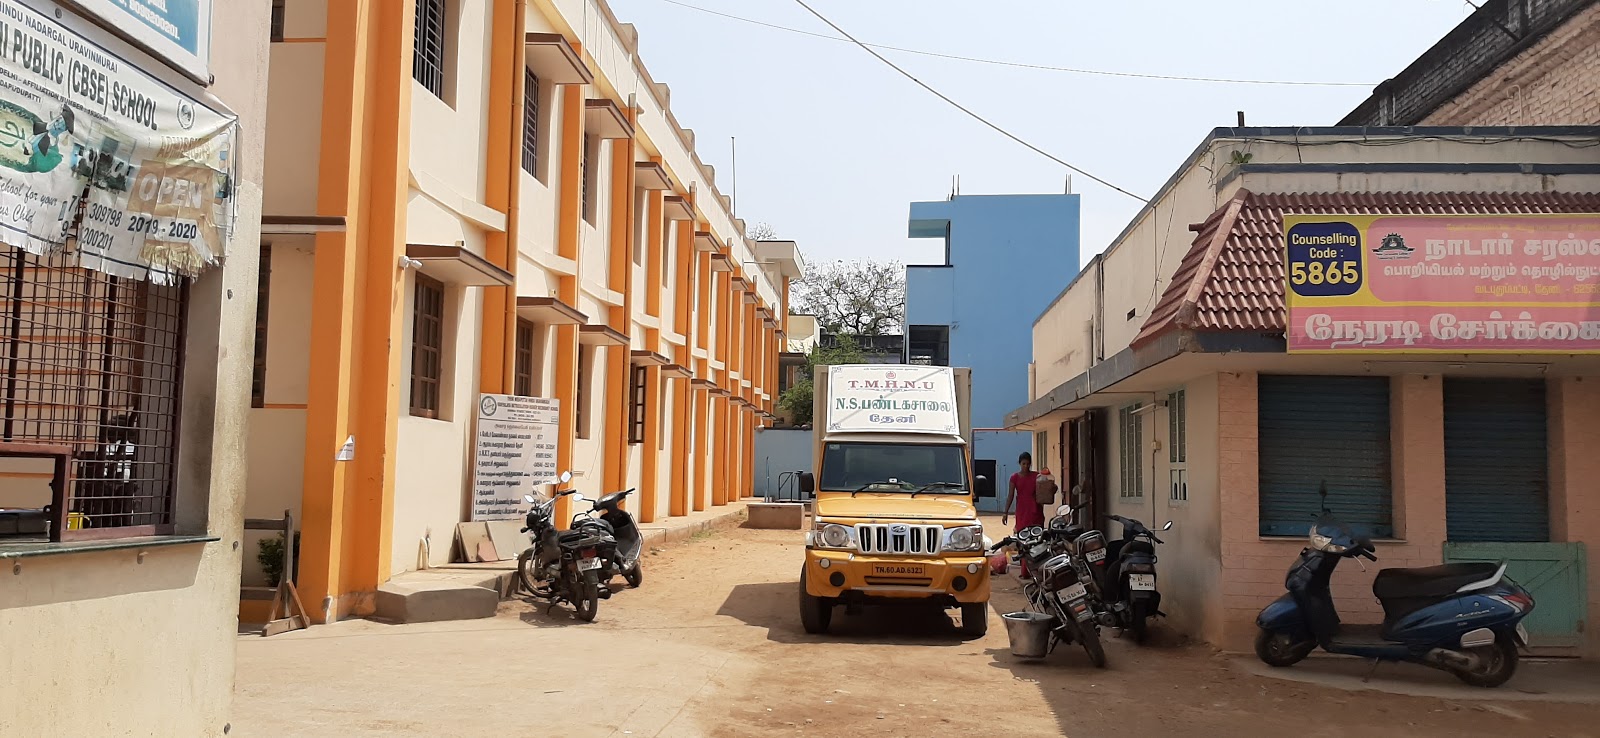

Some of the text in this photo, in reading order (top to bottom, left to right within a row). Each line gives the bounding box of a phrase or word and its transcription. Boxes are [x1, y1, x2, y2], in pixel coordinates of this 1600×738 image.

[0, 1, 118, 73] INDU NADARGAL URAVINMURAI
[13, 28, 64, 85] PUBLIC
[67, 57, 109, 116] (CBSE)
[112, 81, 158, 131] SCHOOL
[22, 79, 60, 100] AFFILIATION
[25, 185, 38, 203] for
[40, 194, 58, 207] your
[138, 172, 205, 209] OPEN
[12, 203, 37, 224] Child
[127, 215, 159, 235] 2019
[168, 221, 197, 239] 2020
[1291, 232, 1357, 246] Counselling
[1425, 232, 1514, 262] நாடார்
[1309, 247, 1338, 259] Code
[1291, 261, 1359, 285] 5865
[1383, 261, 1600, 281] பொறியியல் மற்றும் தொழில்நுட்
[1305, 313, 1423, 349] நேரடி
[848, 380, 935, 390] T.M.H.N.U
[869, 413, 917, 424] தேனி
